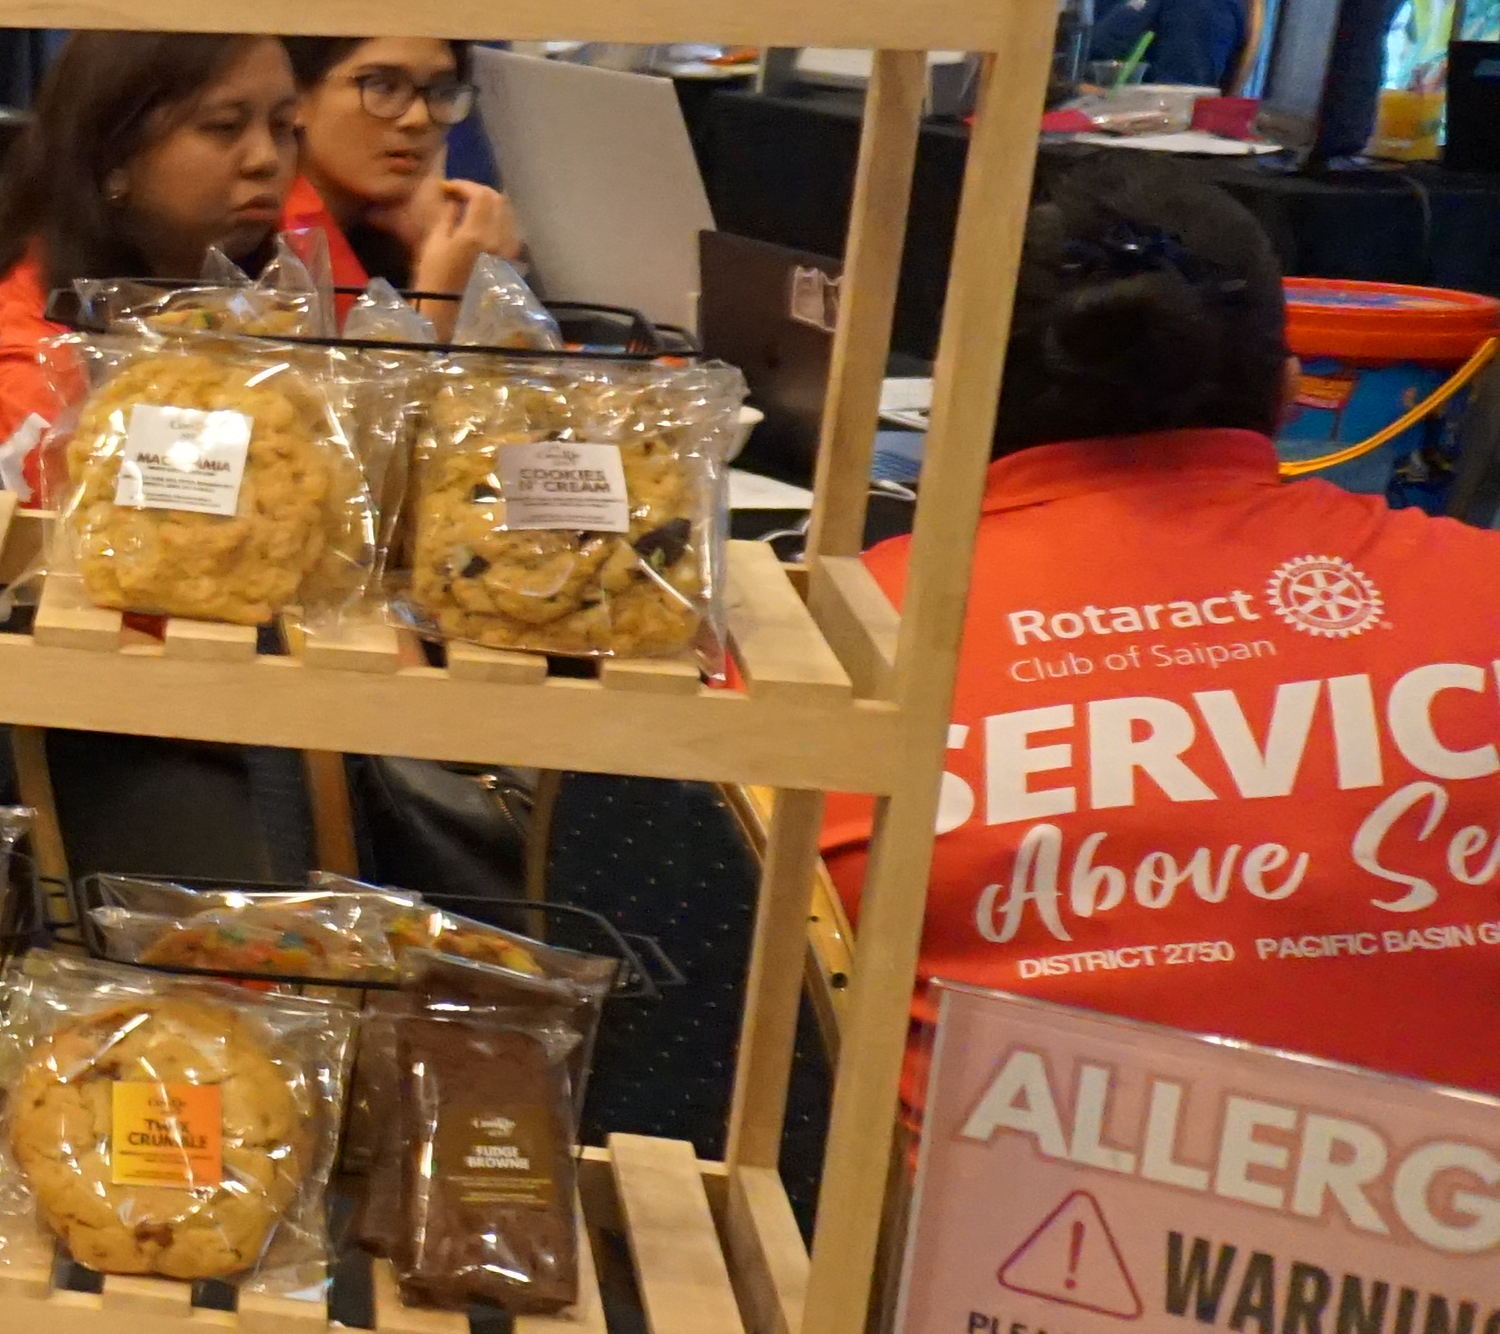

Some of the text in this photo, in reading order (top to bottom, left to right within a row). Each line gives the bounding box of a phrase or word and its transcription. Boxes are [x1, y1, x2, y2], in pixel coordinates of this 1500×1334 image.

[519, 469, 607, 481] COOKIES
[544, 482, 611, 493] CREAM
[1008, 587, 1261, 648] Rotaract
[1008, 635, 1277, 685] Club of Saipan
[975, 823, 1311, 944] Above
[1017, 924, 1471, 980] DISTRICT 2750 PACIFIC BASIN
